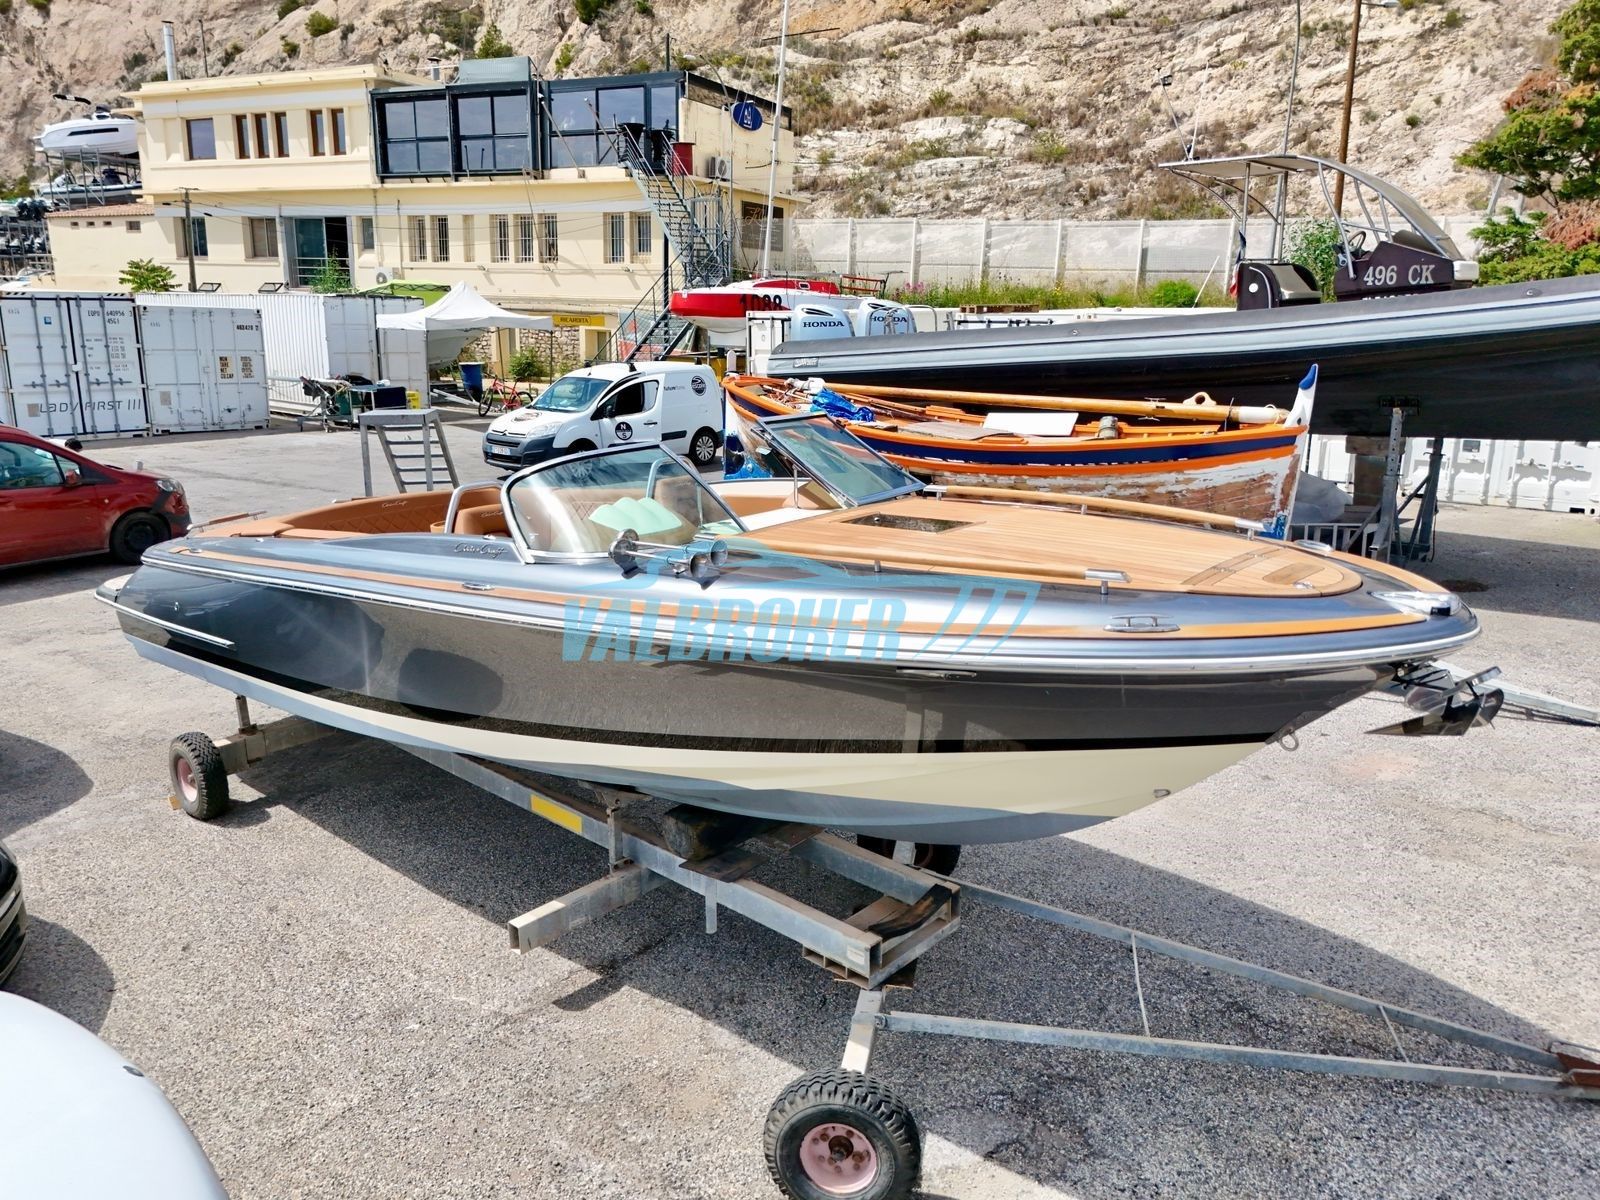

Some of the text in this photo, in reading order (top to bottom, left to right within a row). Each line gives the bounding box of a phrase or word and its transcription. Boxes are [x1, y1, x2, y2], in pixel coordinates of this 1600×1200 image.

[1363, 264, 1436, 286] 496 CK
[802, 320, 845, 328] HONDA
[84, 400, 123, 411] FIRST
